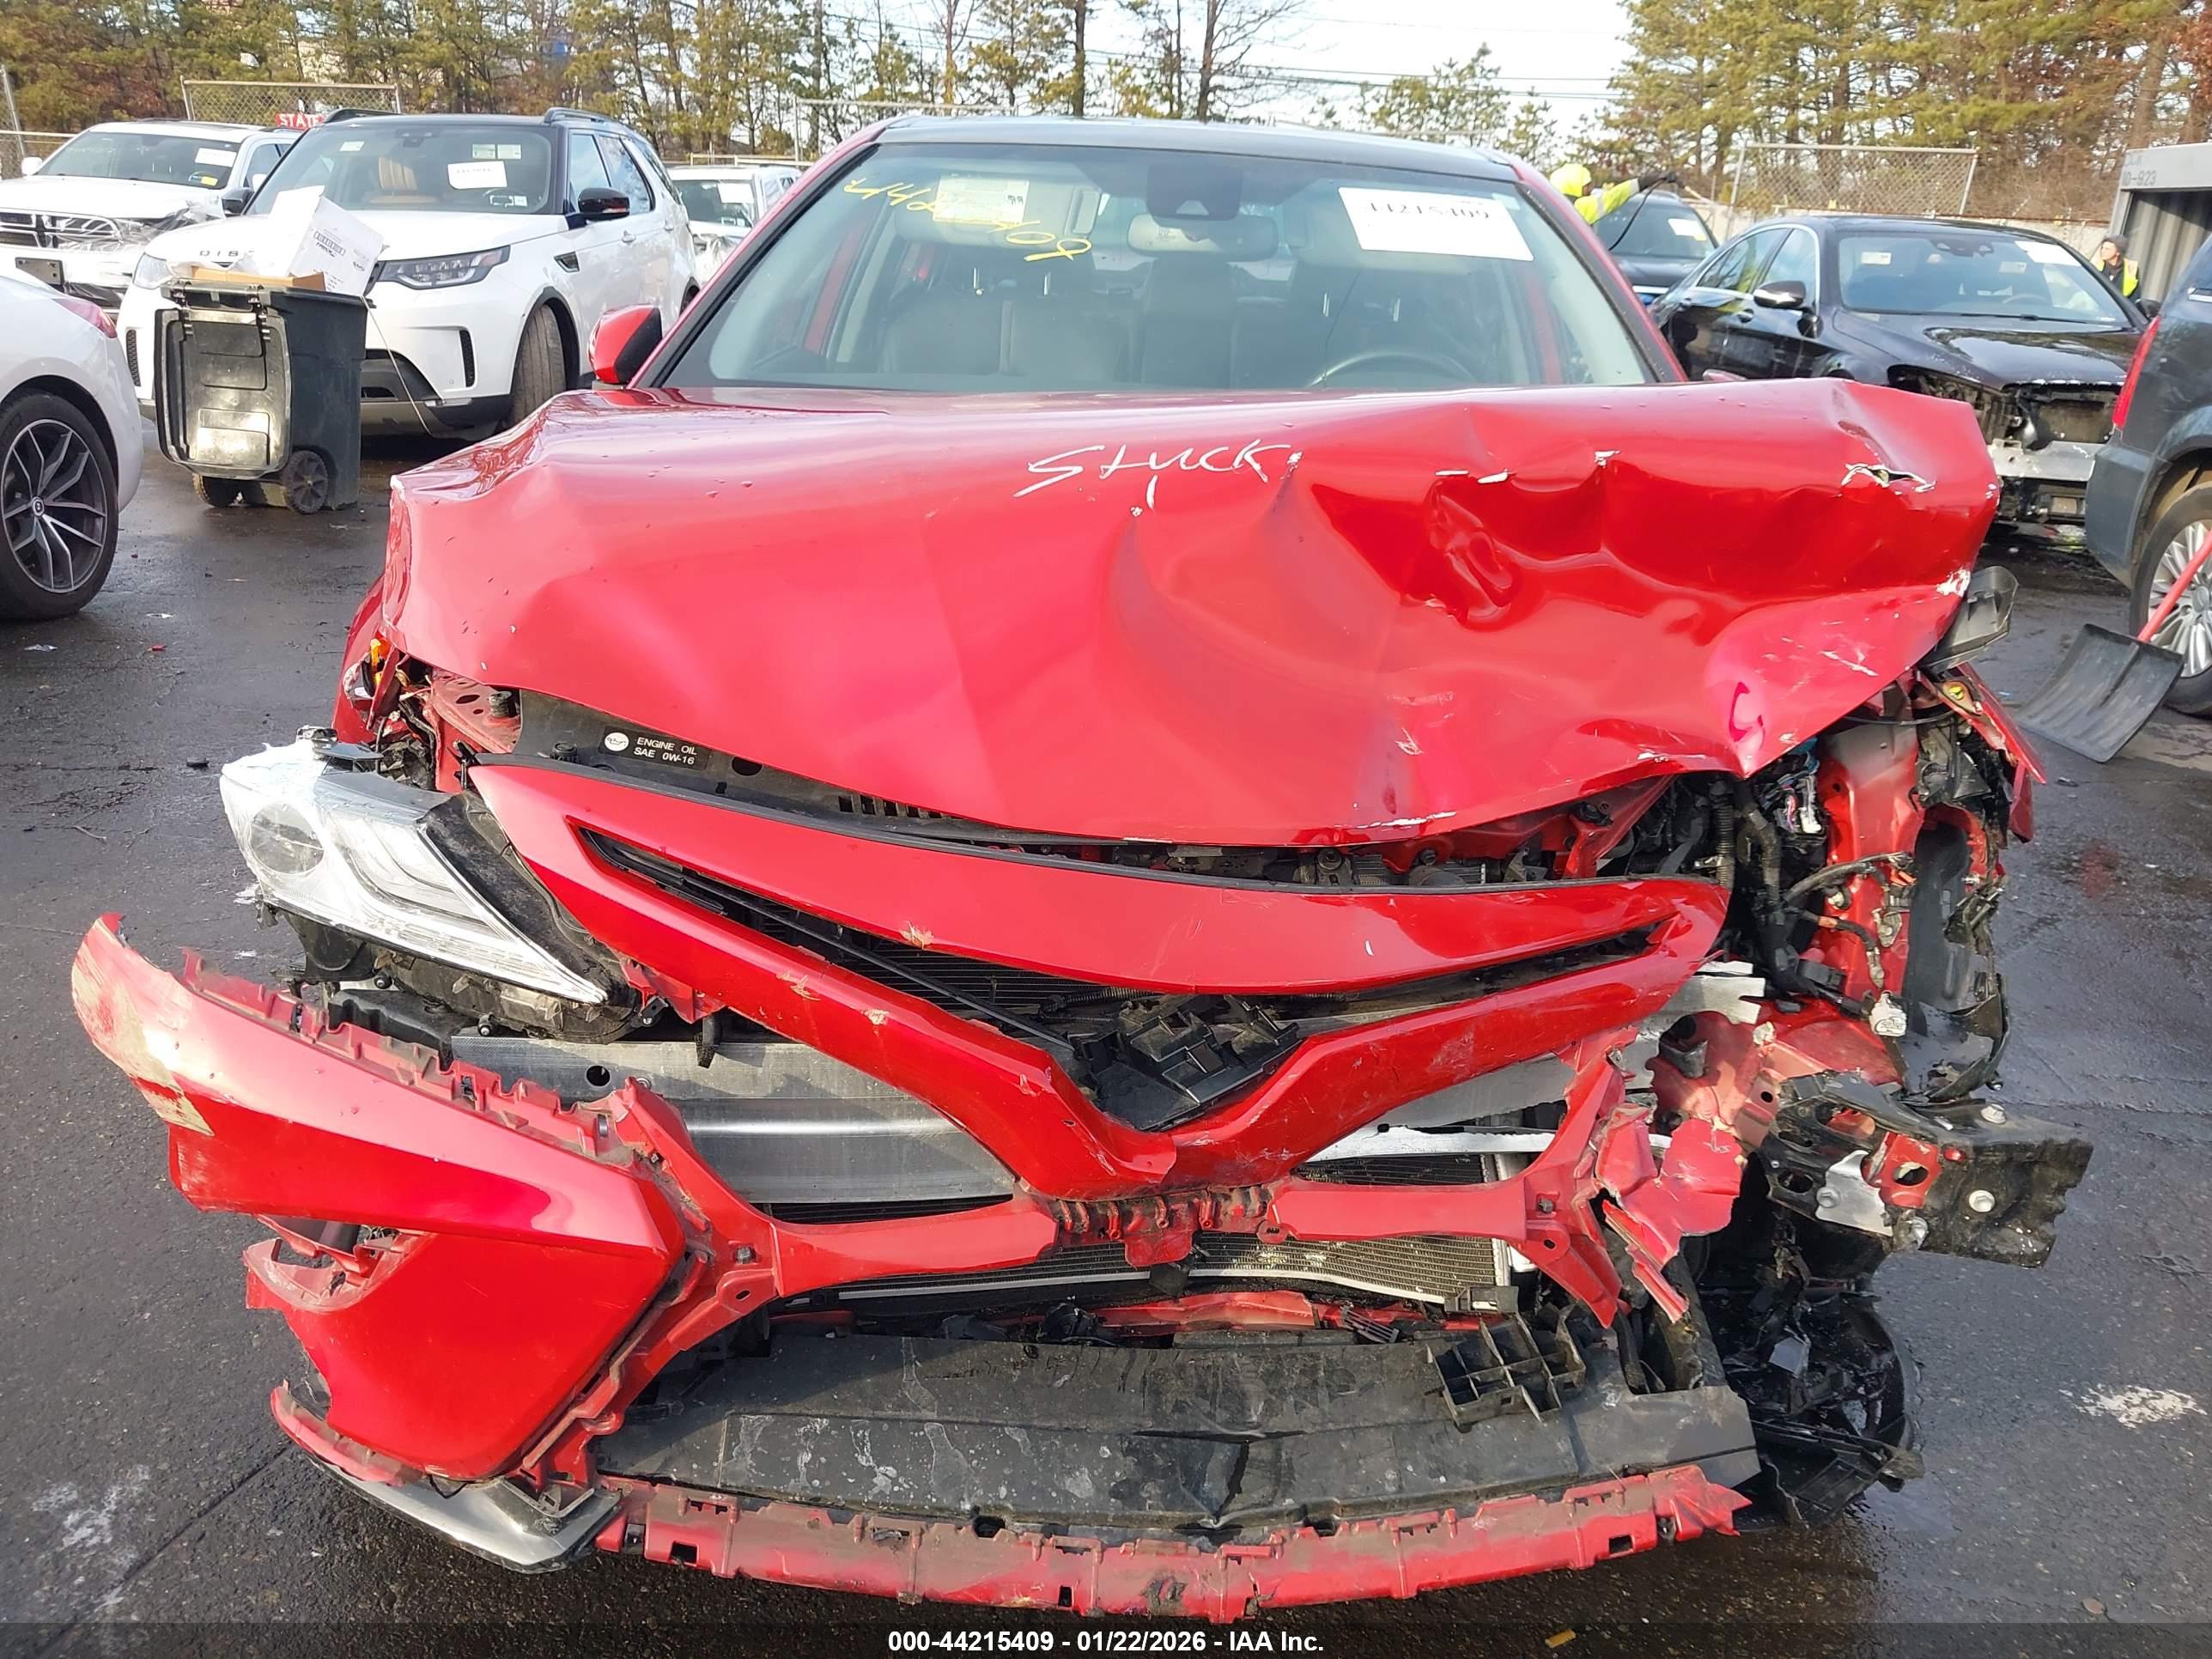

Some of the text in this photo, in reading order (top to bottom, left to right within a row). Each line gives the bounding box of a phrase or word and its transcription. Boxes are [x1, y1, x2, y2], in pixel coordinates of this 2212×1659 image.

[279, 112, 321, 128] STATE
[636, 737, 697, 756] ENGINE OIL
[633, 747, 695, 765] SAE 0W-16
